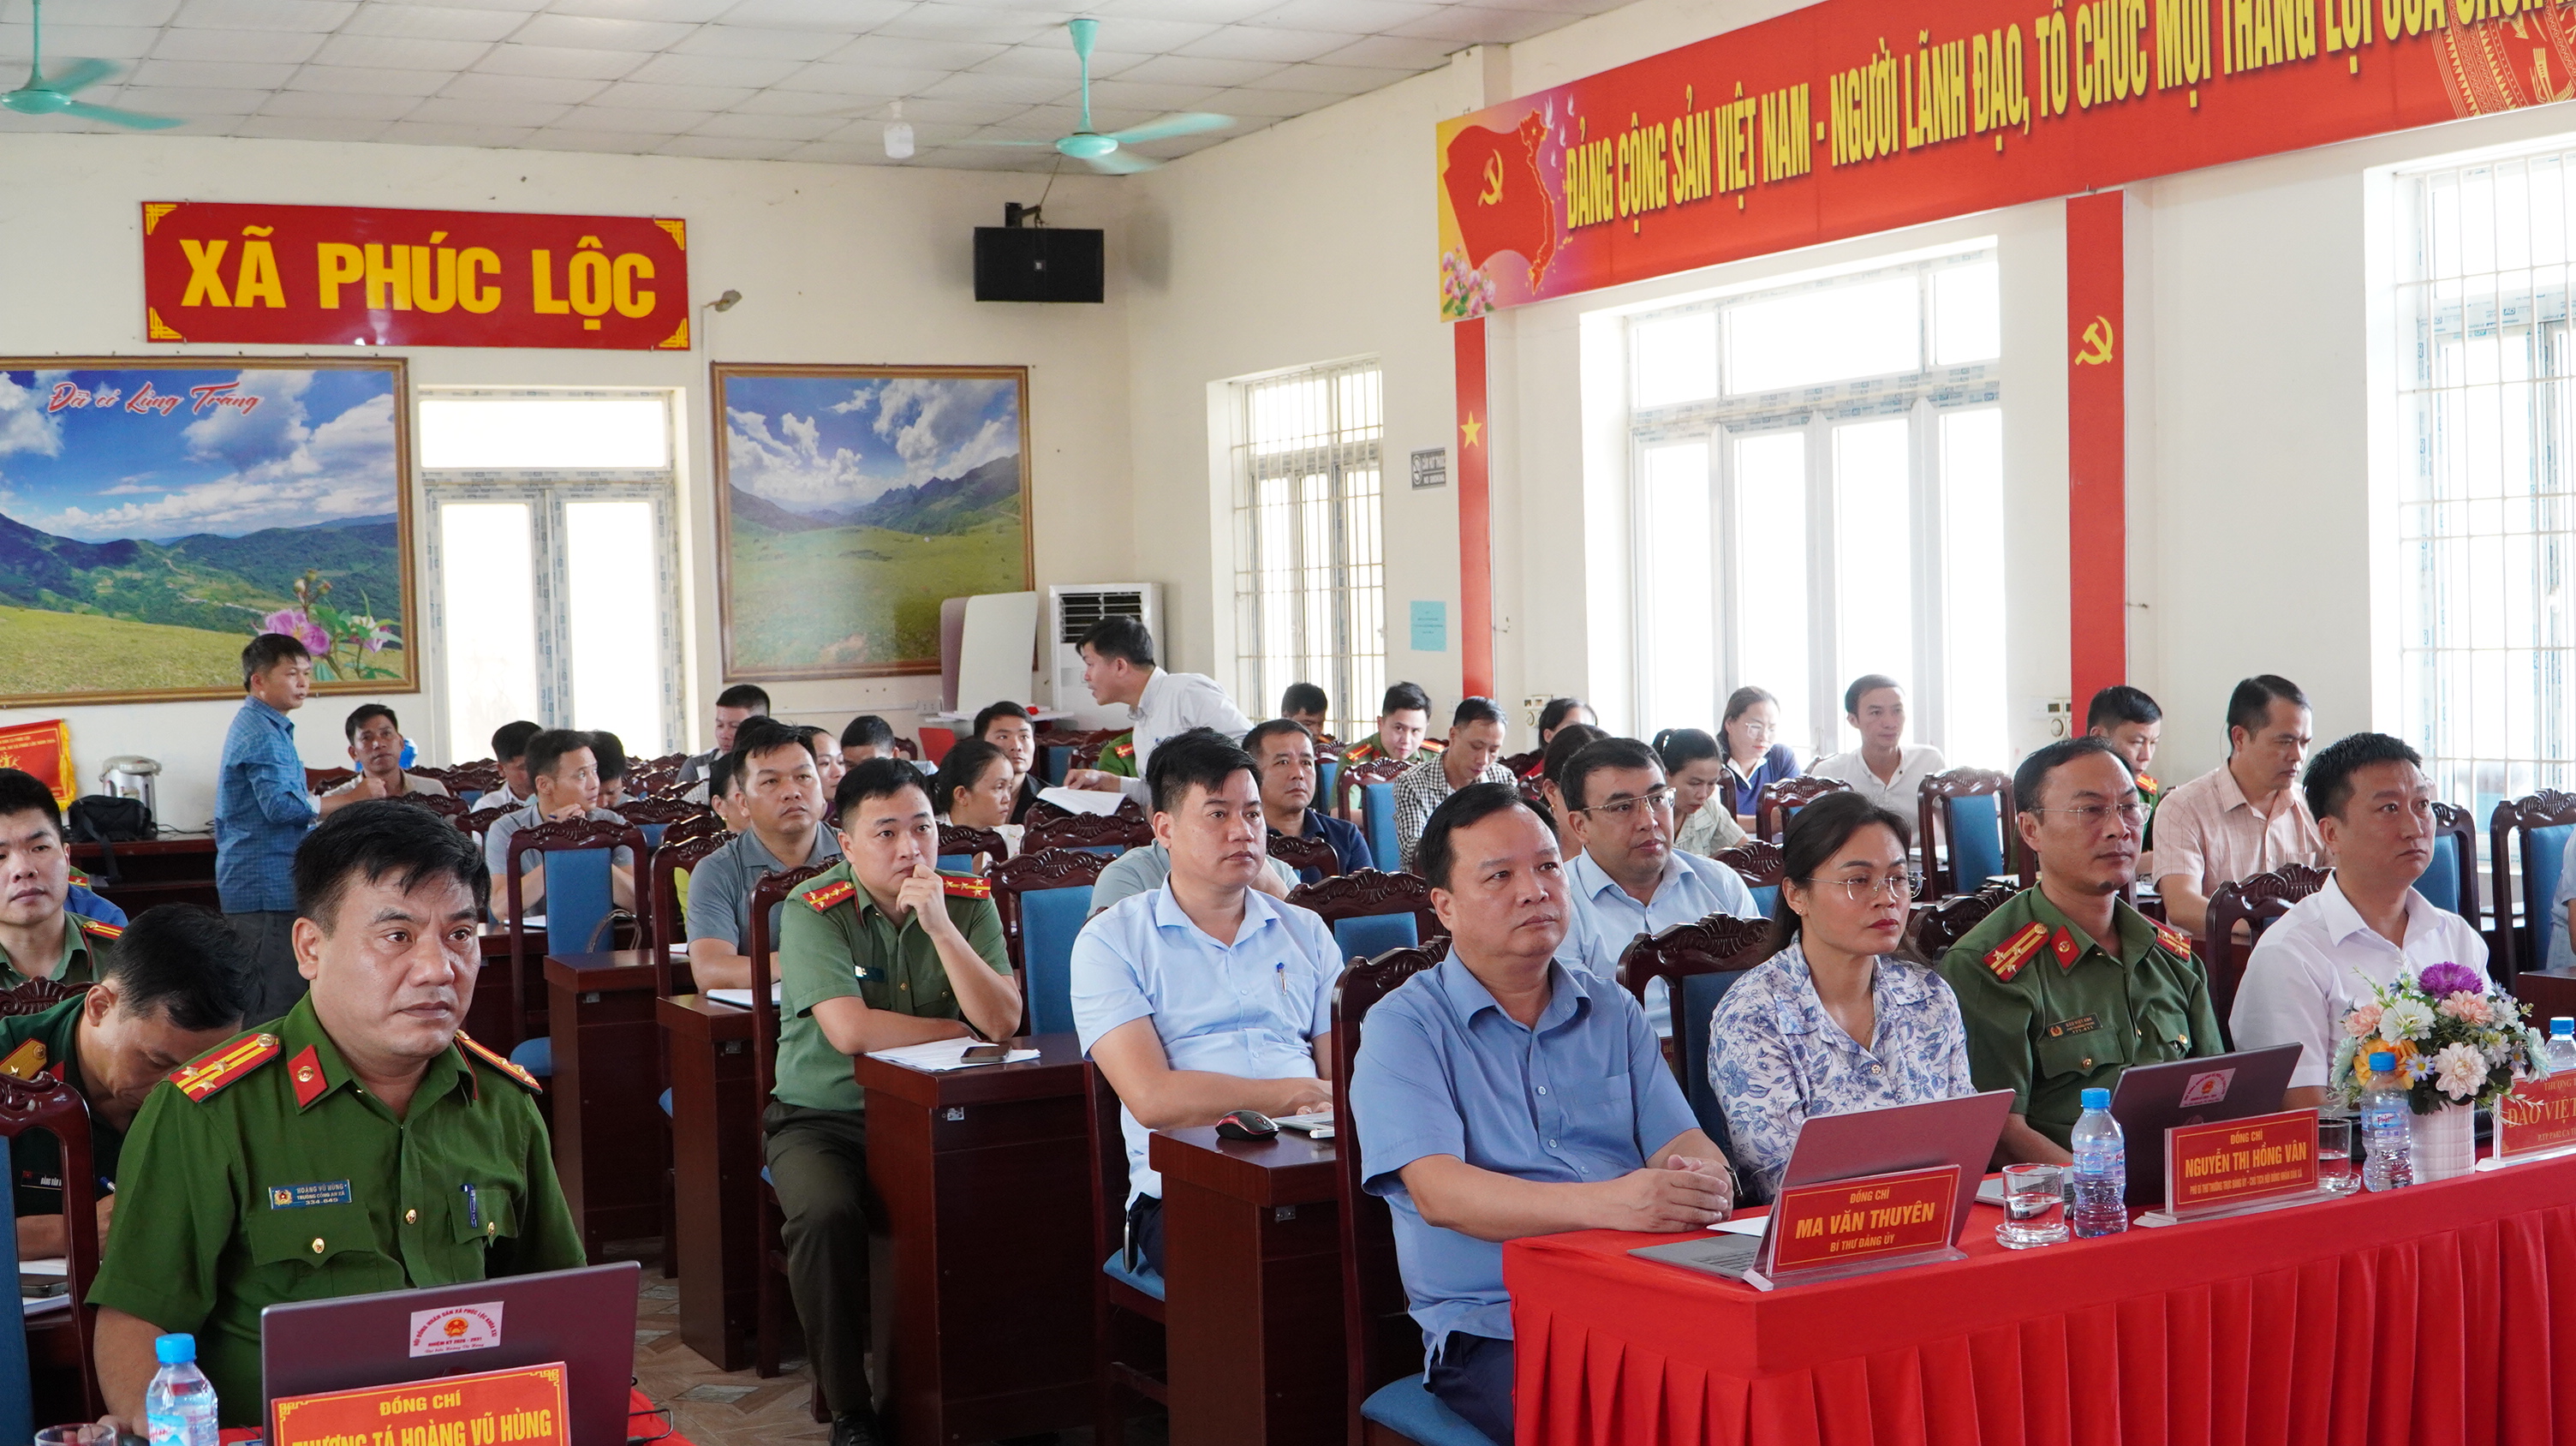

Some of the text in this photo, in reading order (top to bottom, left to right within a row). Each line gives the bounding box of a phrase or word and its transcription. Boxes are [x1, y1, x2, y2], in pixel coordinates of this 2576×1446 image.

[1566, 117, 1614, 229] ĐẢNG
[1619, 112, 1667, 233] CỘNG
[1672, 84, 1711, 205] SẢN
[1714, 81, 1756, 210] VIỆT
[1762, 82, 1810, 182] NAM
[1830, 37, 1899, 166] NGƯỜI
[1905, 28, 1966, 148] LÃNH
[1972, 23, 2029, 152] ĐẠO,
[2156, 0, 2211, 108] MỌI
[179, 224, 656, 330] XÃ PHÚC LỘC
[2230, 1128, 2263, 1144] ĐỒNG CHÍ
[2185, 1139, 2307, 1178] NGUYỄN THỊ HỒNG VÂN
[296, 1186, 317, 1194] HOÀNG
[1850, 1186, 1890, 1204] ĐỒNG CHÍ
[1795, 1200, 1935, 1240] MA VĂN THUYÊN
[1830, 1240, 1840, 1252] BÍ
[1841, 1238, 1857, 1251] THƯ
[1858, 1235, 1882, 1248] ĐẢNG
[379, 1389, 462, 1416] ĐỒNG CHÍ
[401, 1419, 466, 1446] HOÀNG
[470, 1412, 495, 1446] VŨ
[500, 1407, 552, 1443] HÙNG
